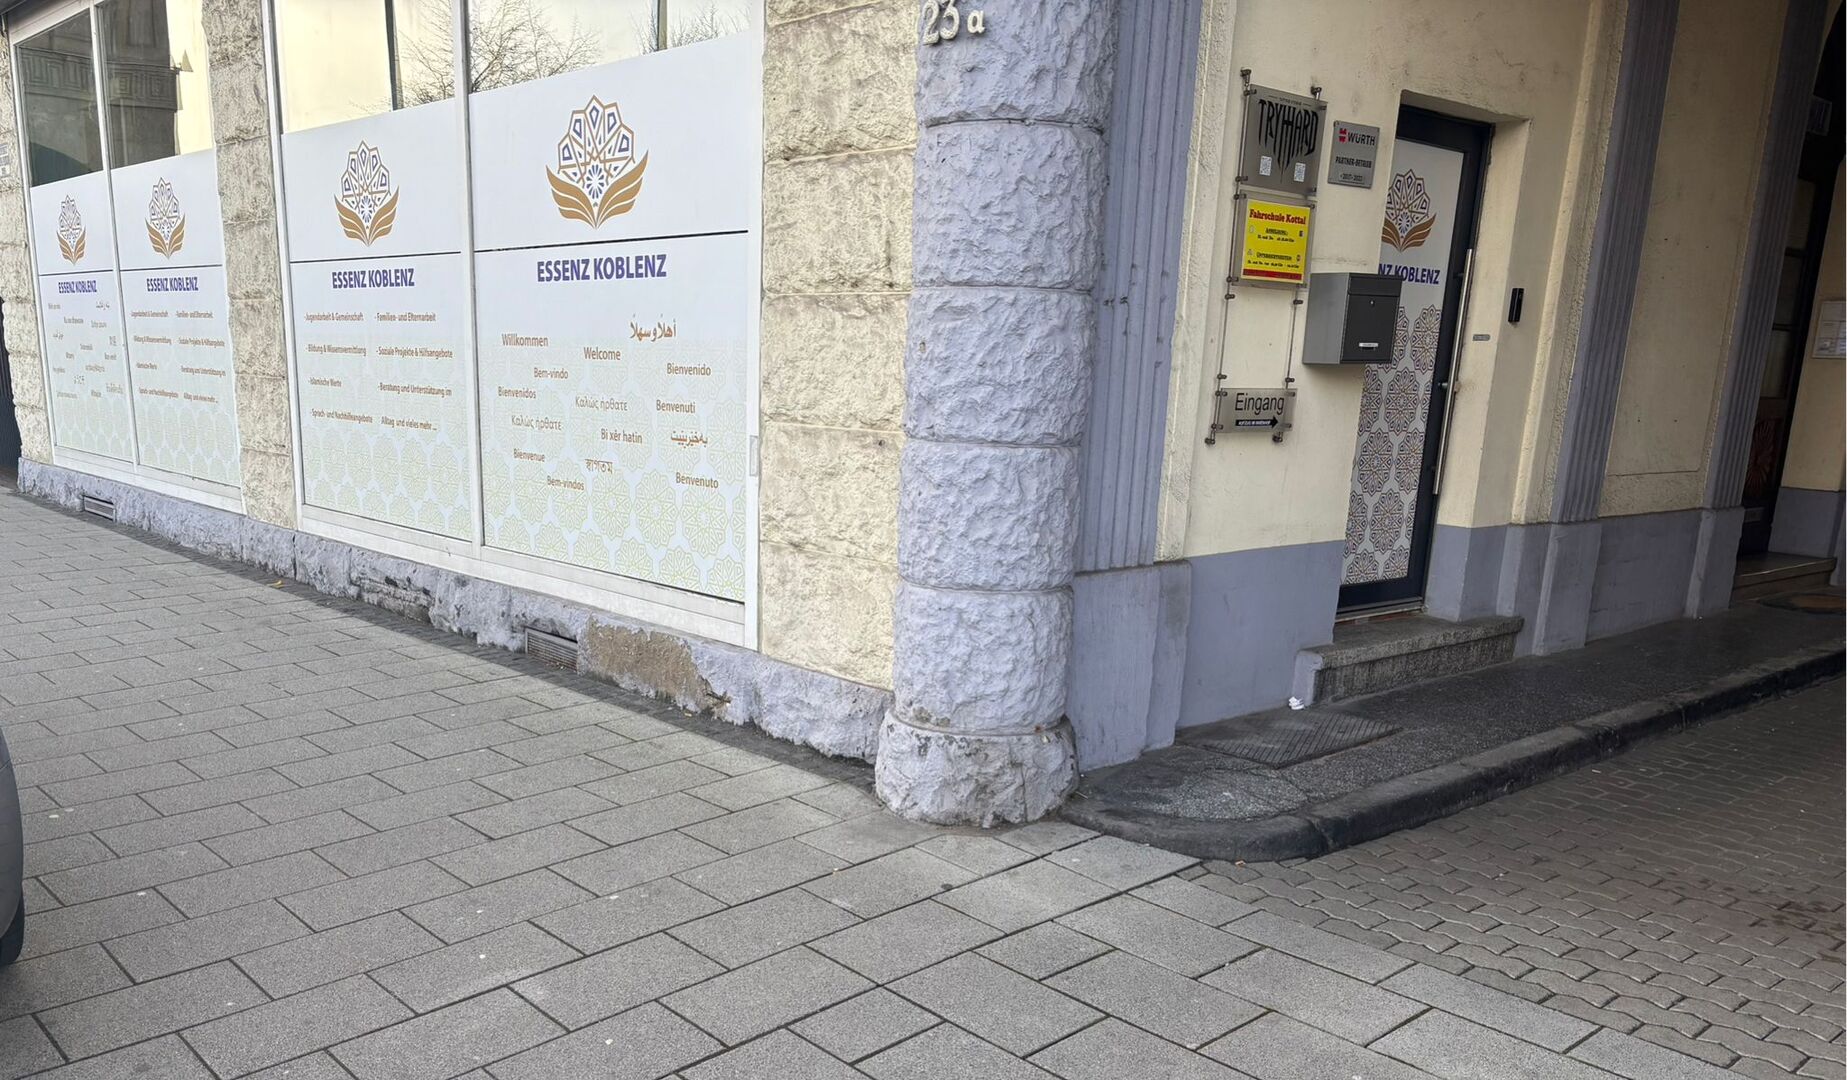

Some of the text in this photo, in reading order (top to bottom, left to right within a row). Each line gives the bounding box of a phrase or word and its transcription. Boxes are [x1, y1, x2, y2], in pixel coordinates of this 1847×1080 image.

[922, 0, 985, 43] 23 a
[1347, 132, 1376, 146] WÜRTH
[1249, 208, 1285, 222] Fahrschule
[537, 254, 667, 282] ESSENZ KOBLENZ
[1394, 265, 1440, 285] KOBLENZ
[146, 276, 199, 292] ESSENZ KOBLENZ
[332, 268, 415, 289] ESSENZ KOBLENZ
[501, 333, 549, 347] Willkommen
[583, 347, 621, 361] Welcome
[533, 367, 569, 380] Bem-vindo
[666, 362, 711, 376] Bienvenido
[498, 386, 537, 399] Bienvenidos
[656, 400, 696, 414] Benvenuti
[1235, 393, 1285, 415] Eingang
[601, 428, 608, 440] Bi
[622, 430, 643, 444] hatin
[513, 448, 545, 462] Bienvenue
[547, 475, 585, 491] Bem-vindos
[676, 471, 719, 489] Benvenuto
